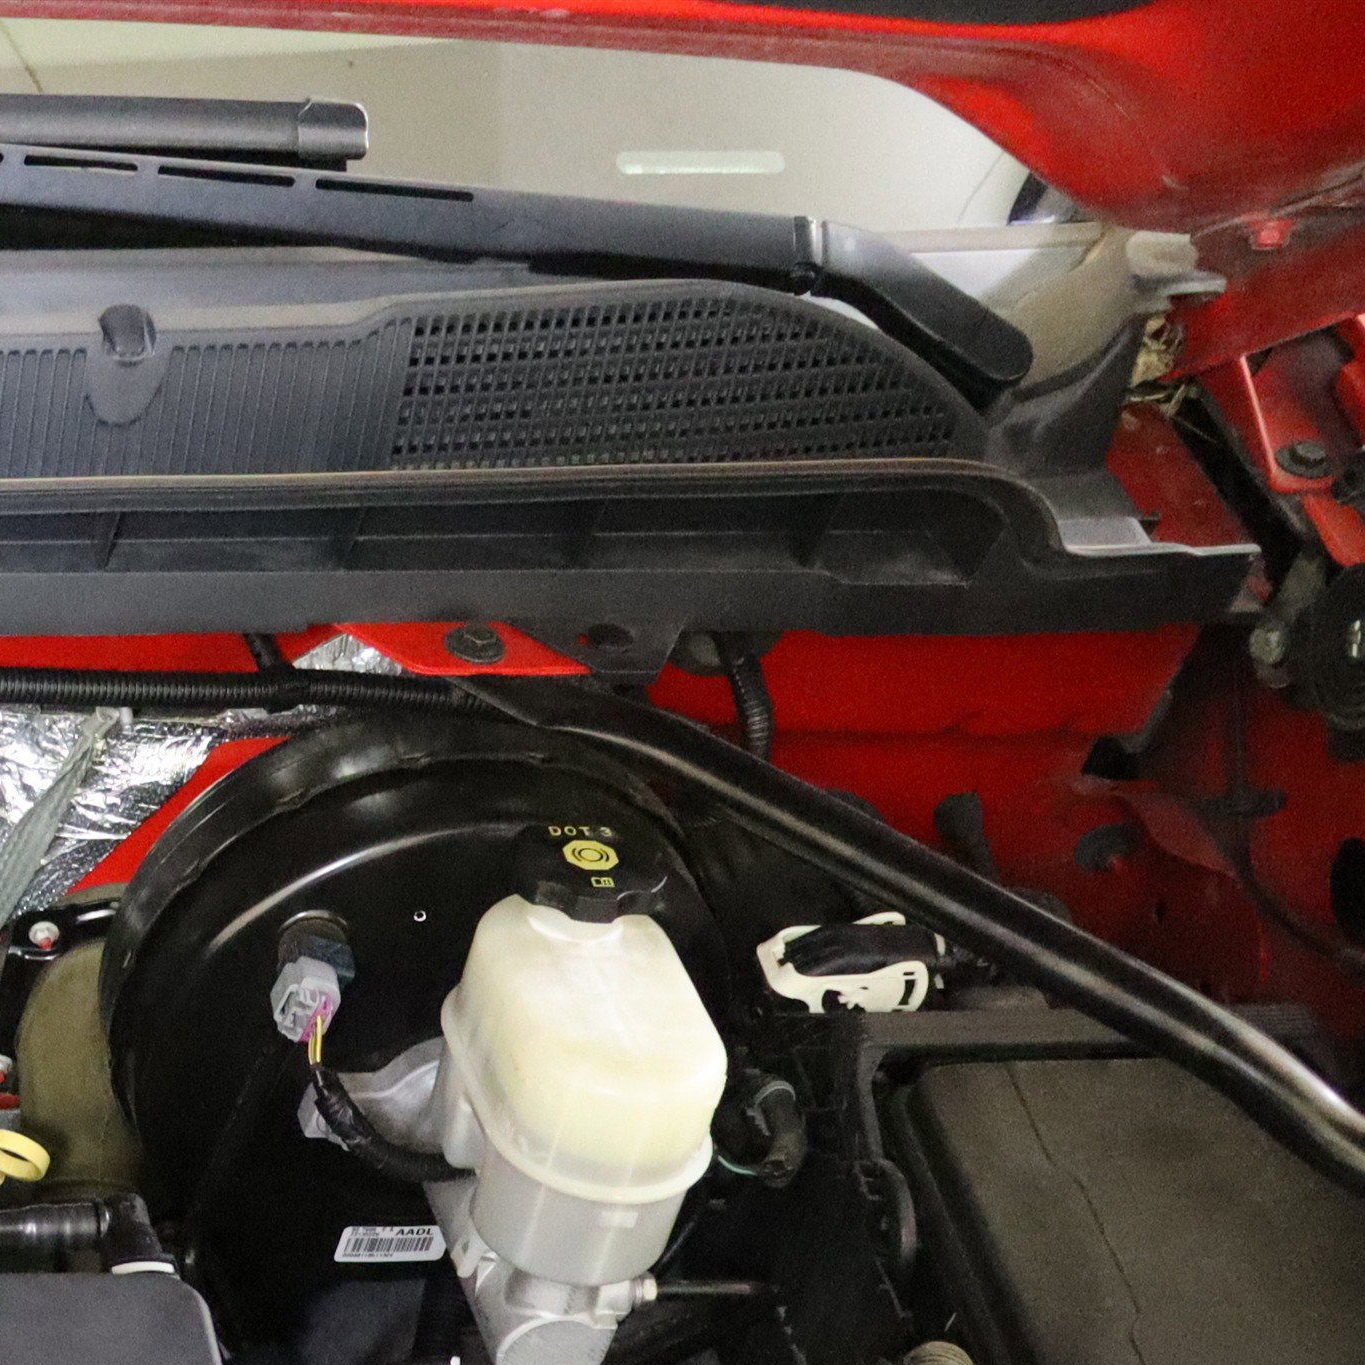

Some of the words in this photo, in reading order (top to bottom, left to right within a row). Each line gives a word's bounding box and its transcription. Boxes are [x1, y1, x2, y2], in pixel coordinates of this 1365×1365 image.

[548, 826, 590, 837] DOT
[600, 827, 612, 838] 3
[395, 1228, 434, 1236] AADL
